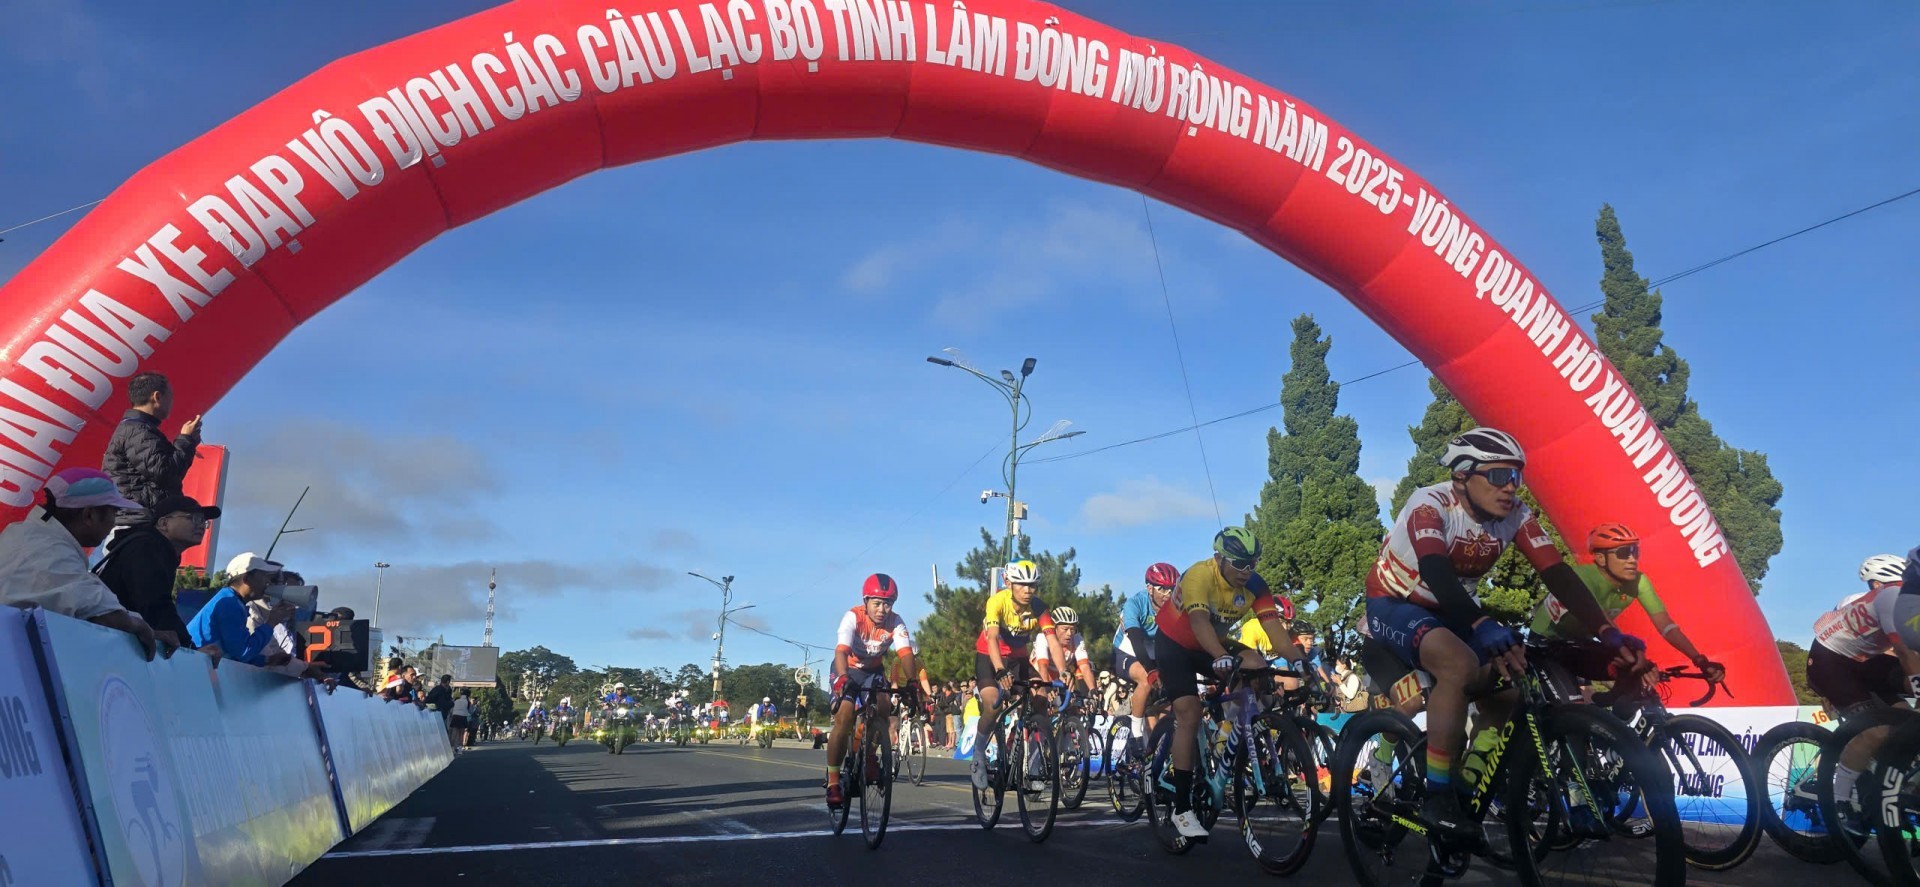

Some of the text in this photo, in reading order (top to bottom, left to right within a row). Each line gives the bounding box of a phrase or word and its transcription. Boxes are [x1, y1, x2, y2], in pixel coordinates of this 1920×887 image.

[17, 289, 172, 411] ĐUA
[117, 223, 236, 323] XE
[186, 155, 316, 268] ĐẠP
[286, 109, 384, 200] VÔ
[357, 64, 494, 169] ĐỊCH
[472, 31, 581, 121] CÁC
[577, 9, 677, 93] CÂU
[670, 0, 762, 80] LẠC
[925, 1, 1008, 77] LÂM
[1111, 44, 1165, 113] MỞ
[1166, 62, 1252, 139] RỘNG
[1253, 94, 1329, 172] NĂM
[1475, 249, 1571, 357] QUANH
[1584, 369, 1663, 469] XUÂN
[1642, 452, 1728, 568] HƯƠNG
[1844, 603, 1878, 638] 128
[1395, 672, 1422, 703] 171
[1245, 724, 1259, 765] FACTOR
[1391, 814, 1429, 836] S-WORKS
